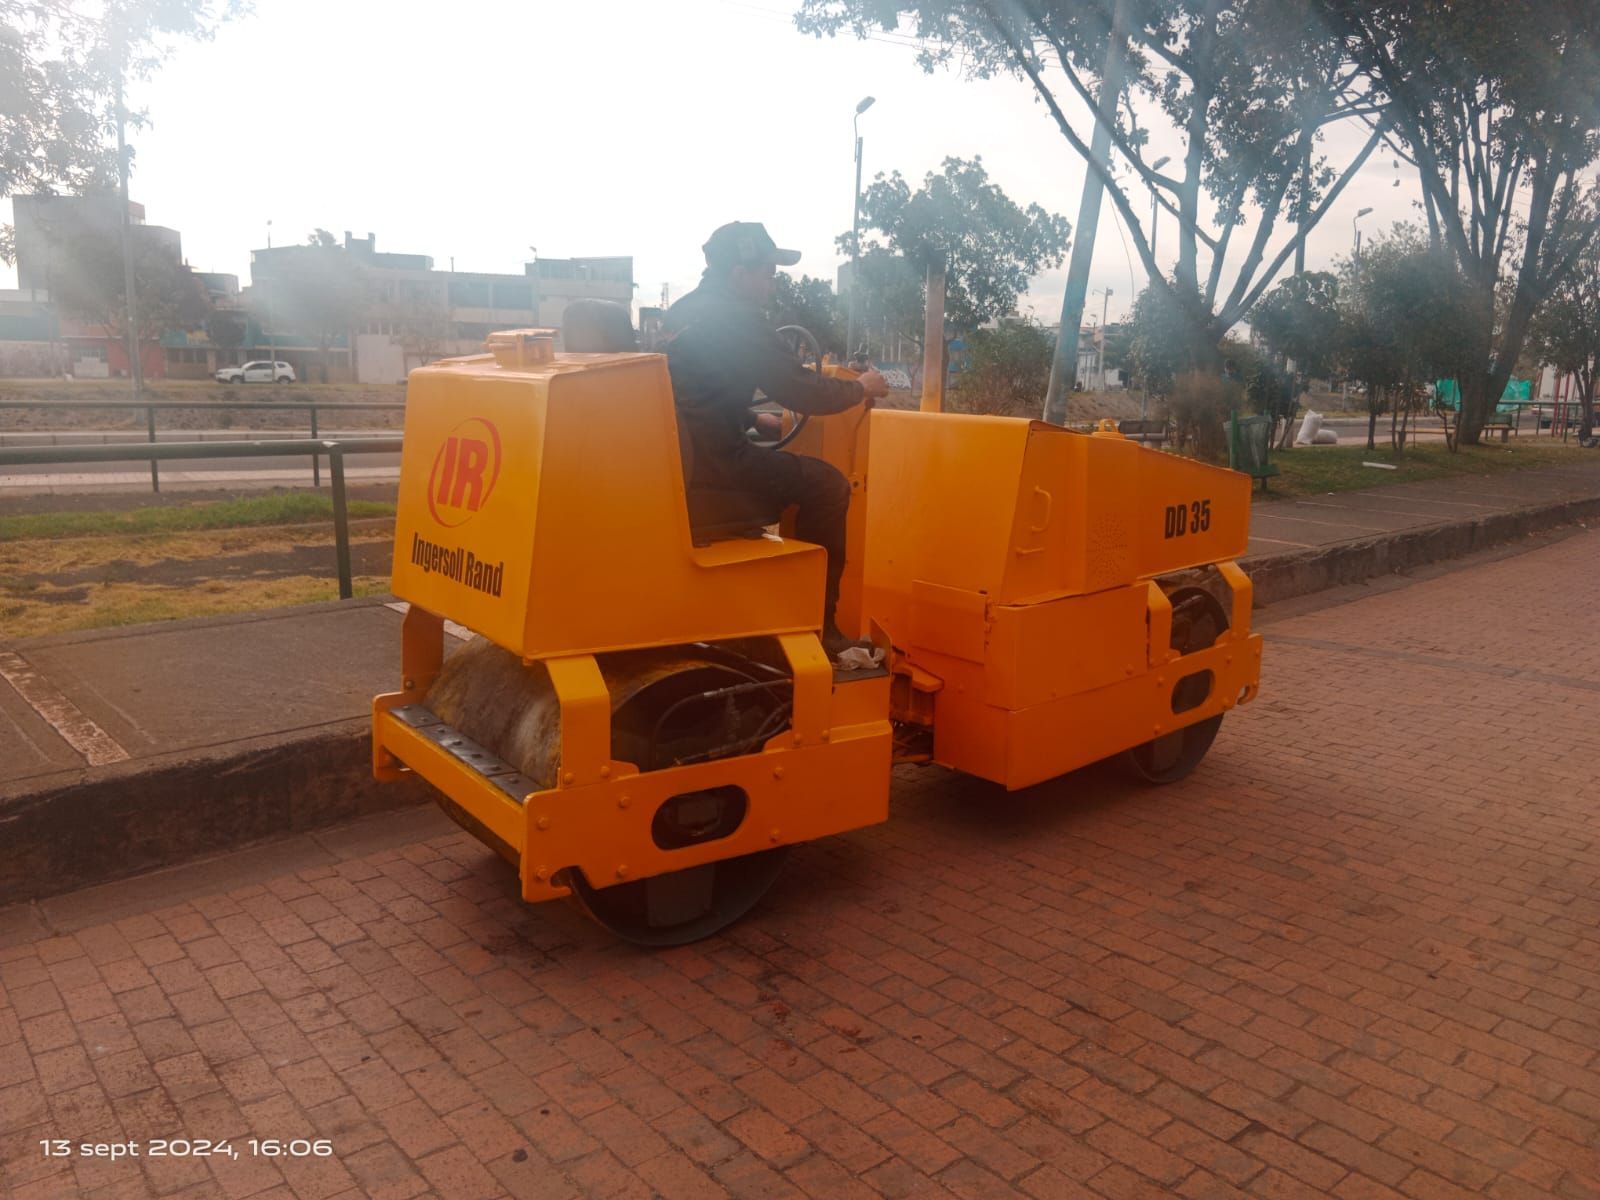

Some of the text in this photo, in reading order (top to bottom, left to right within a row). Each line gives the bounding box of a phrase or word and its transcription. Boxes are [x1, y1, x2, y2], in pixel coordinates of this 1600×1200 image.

[436, 437, 489, 512] IR
[1164, 499, 1211, 540] DD 35
[411, 532, 504, 598] Ingersoll Rand
